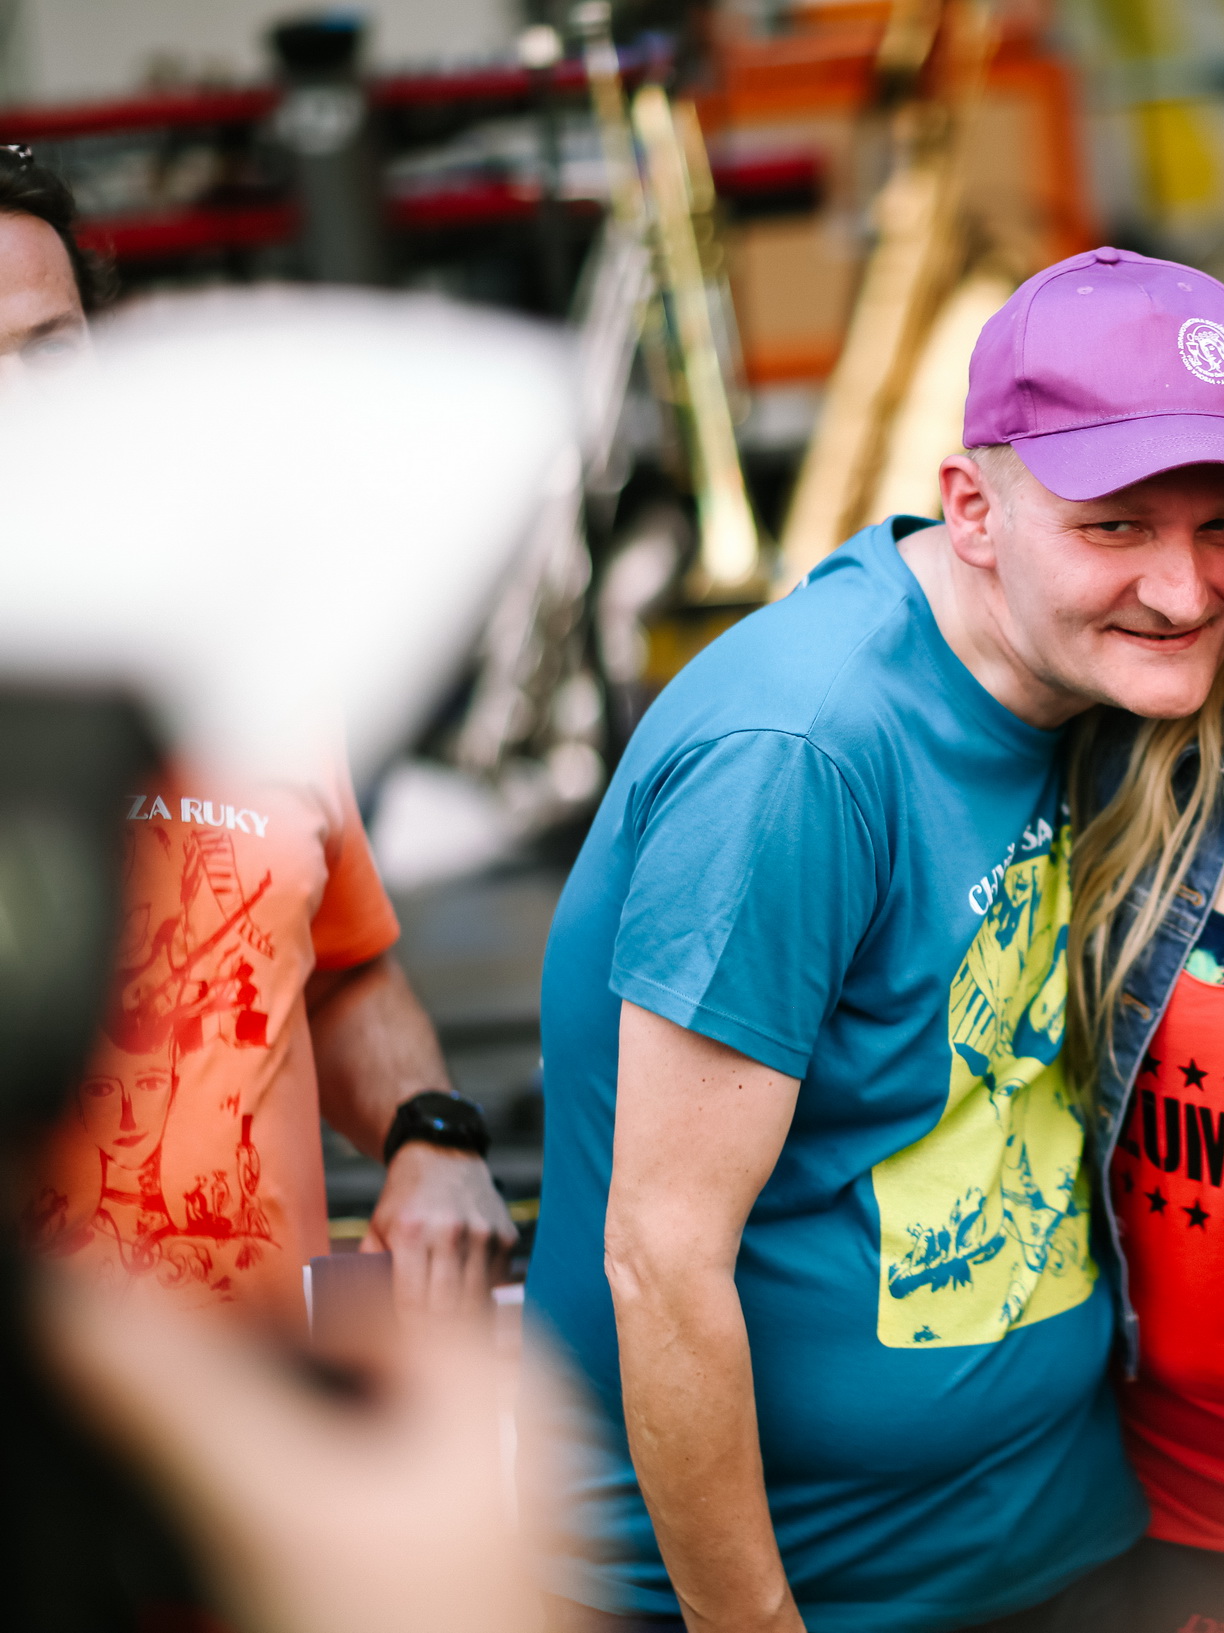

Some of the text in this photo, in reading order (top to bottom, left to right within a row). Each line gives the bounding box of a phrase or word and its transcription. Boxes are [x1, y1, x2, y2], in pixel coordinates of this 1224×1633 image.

[126, 795, 268, 838] ZA RUKY
[1021, 818, 1053, 850] SA
